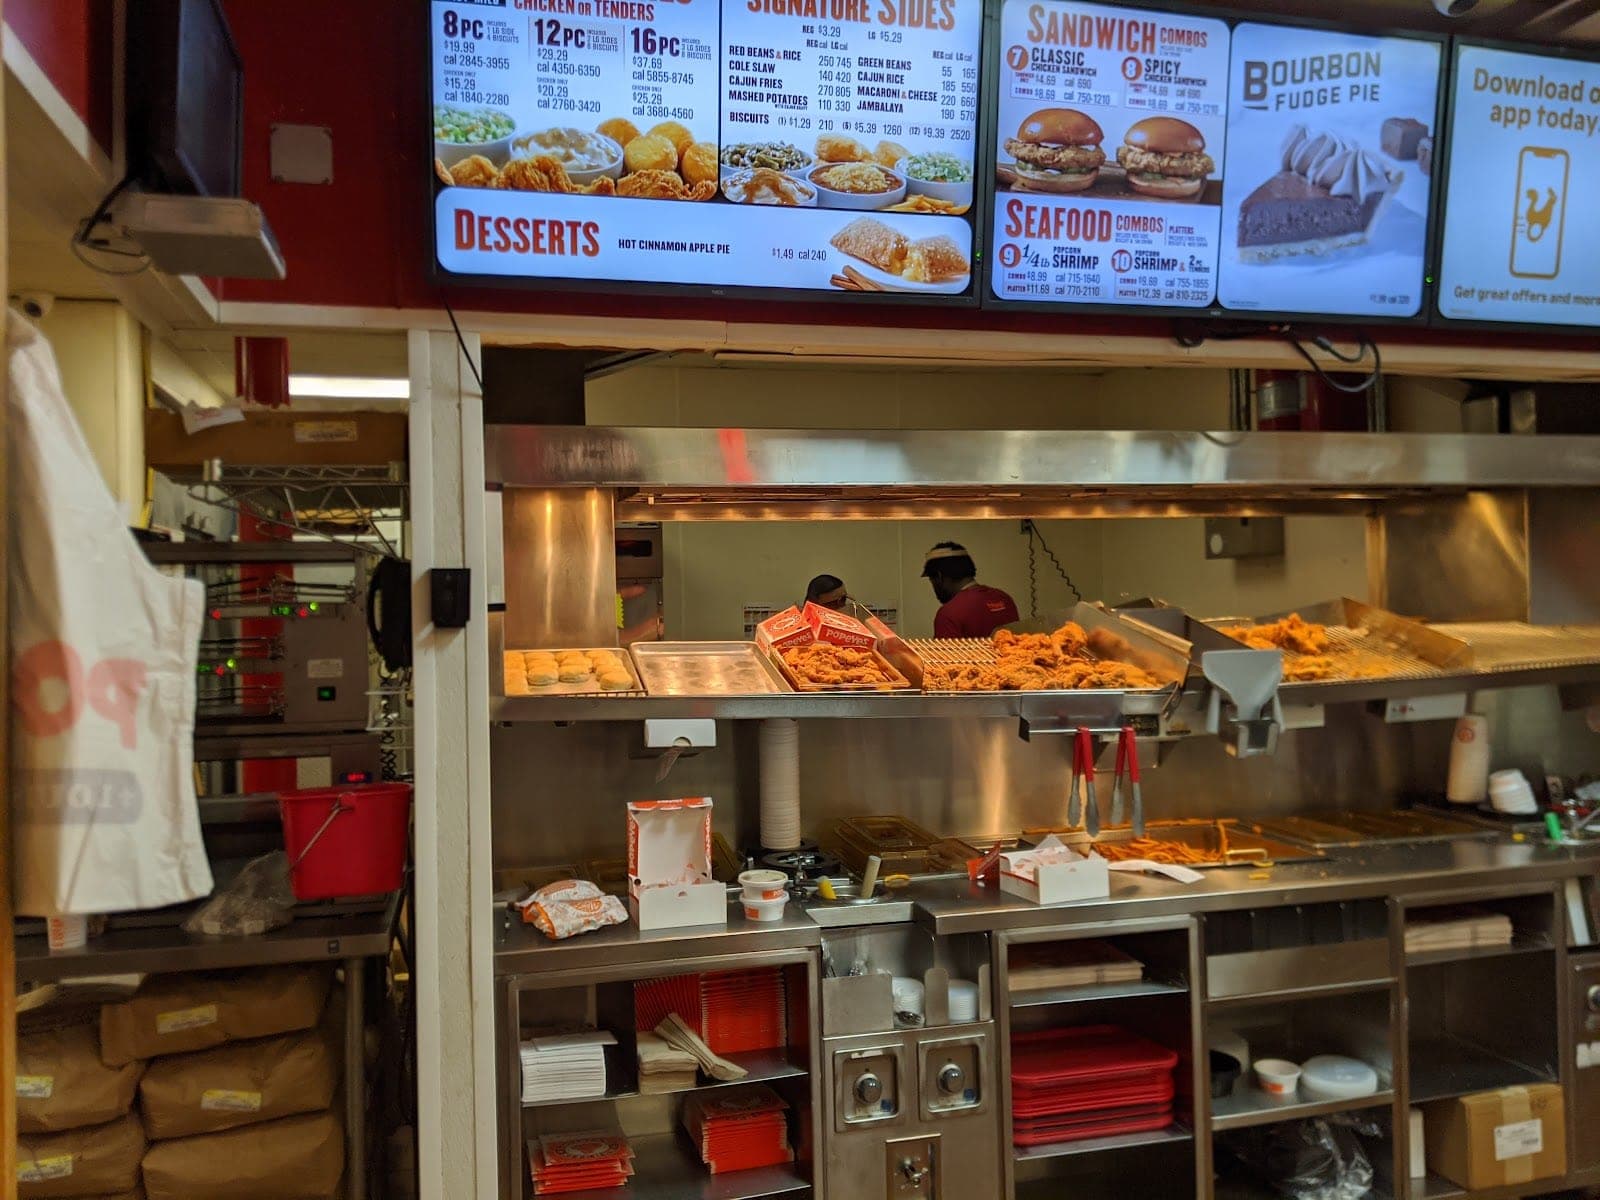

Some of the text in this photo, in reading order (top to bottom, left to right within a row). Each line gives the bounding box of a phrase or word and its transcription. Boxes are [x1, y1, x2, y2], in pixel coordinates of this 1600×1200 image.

[513, 0, 654, 21] CHICKEN OR TENDERS
[878, 0, 955, 31] SIDES
[802, 25, 841, 38] REG $3.29
[1027, 4, 1209, 55] SANDWICH COMBOS
[880, 31, 902, 43] $5.29
[444, 41, 475, 53] $19.99
[729, 45, 744, 56] RED
[747, 47, 775, 59] BEANS
[783, 50, 801, 61] RICE
[537, 48, 568, 61] $29.29
[1032, 48, 1085, 66] CLASSIC
[444, 54, 510, 70] cal 2845-3955
[633, 56, 662, 69] $37.69
[729, 60, 776, 74] COLE SLAW
[818, 56, 851, 68] 250 745
[858, 57, 912, 71] GREEN BEANS
[1145, 59, 1181, 75] SPICY
[537, 63, 601, 77] cal 4350-6350
[819, 70, 851, 82] 140 420
[942, 66, 976, 79] 55 165
[1031, 63, 1097, 77] CHICKEN SANDWICH
[1244, 51, 1382, 101] BOURBON
[445, 78, 475, 90] $15.29
[633, 70, 694, 85] cal 5855-8745
[729, 75, 783, 89] CAJUN FRIES
[857, 71, 905, 85] CAJUN RICE
[1144, 74, 1207, 87] CHICKEN SANDWICH
[537, 85, 568, 97] $20.29
[818, 85, 851, 97] 270 805
[942, 81, 976, 93] 185 550
[1473, 67, 1585, 104] Download
[445, 91, 509, 105] cal 1840-2280
[633, 92, 662, 105] $25.29
[729, 90, 808, 106] MASHED POTATOES
[857, 86, 900, 99] MACARONI
[908, 90, 938, 102] CHEESE
[1275, 84, 1380, 111] FUDGE PIE
[538, 99, 601, 113] cal 2760-3420
[819, 99, 831, 111] 110
[835, 101, 851, 112] 330
[857, 100, 904, 113] JAMBALAYA
[941, 95, 976, 108] 220 660
[633, 106, 645, 116] cal
[941, 109, 975, 122] 190 570
[1490, 104, 1532, 131] app
[730, 112, 769, 124] BISCUITS
[789, 117, 811, 129] $1.29
[818, 119, 833, 131] 210
[854, 122, 877, 134] $5.39
[883, 124, 902, 136] 1260
[923, 127, 945, 139] $9.39
[950, 129, 970, 141] 2520
[1005, 198, 1163, 242] SEAFOOD COMBOS
[453, 208, 600, 258] DESSERTS
[618, 239, 730, 254] HOT CINNAMON APPLE PIE
[1053, 246, 1081, 254] POPCORN
[771, 247, 827, 261] $1.49 cal 240
[1052, 254, 1099, 269] SHRIMP
[1134, 256, 1178, 272] SHRIMP
[1027, 271, 1047, 282] $8.99
[1055, 274, 1065, 282] cal
[1055, 286, 1065, 295] cal
[1454, 286, 1475, 299] Get
[1478, 288, 1510, 302] great
[1512, 289, 1547, 303] offers
[1549, 292, 1571, 305] and
[826, 629, 870, 646] POPEYES
